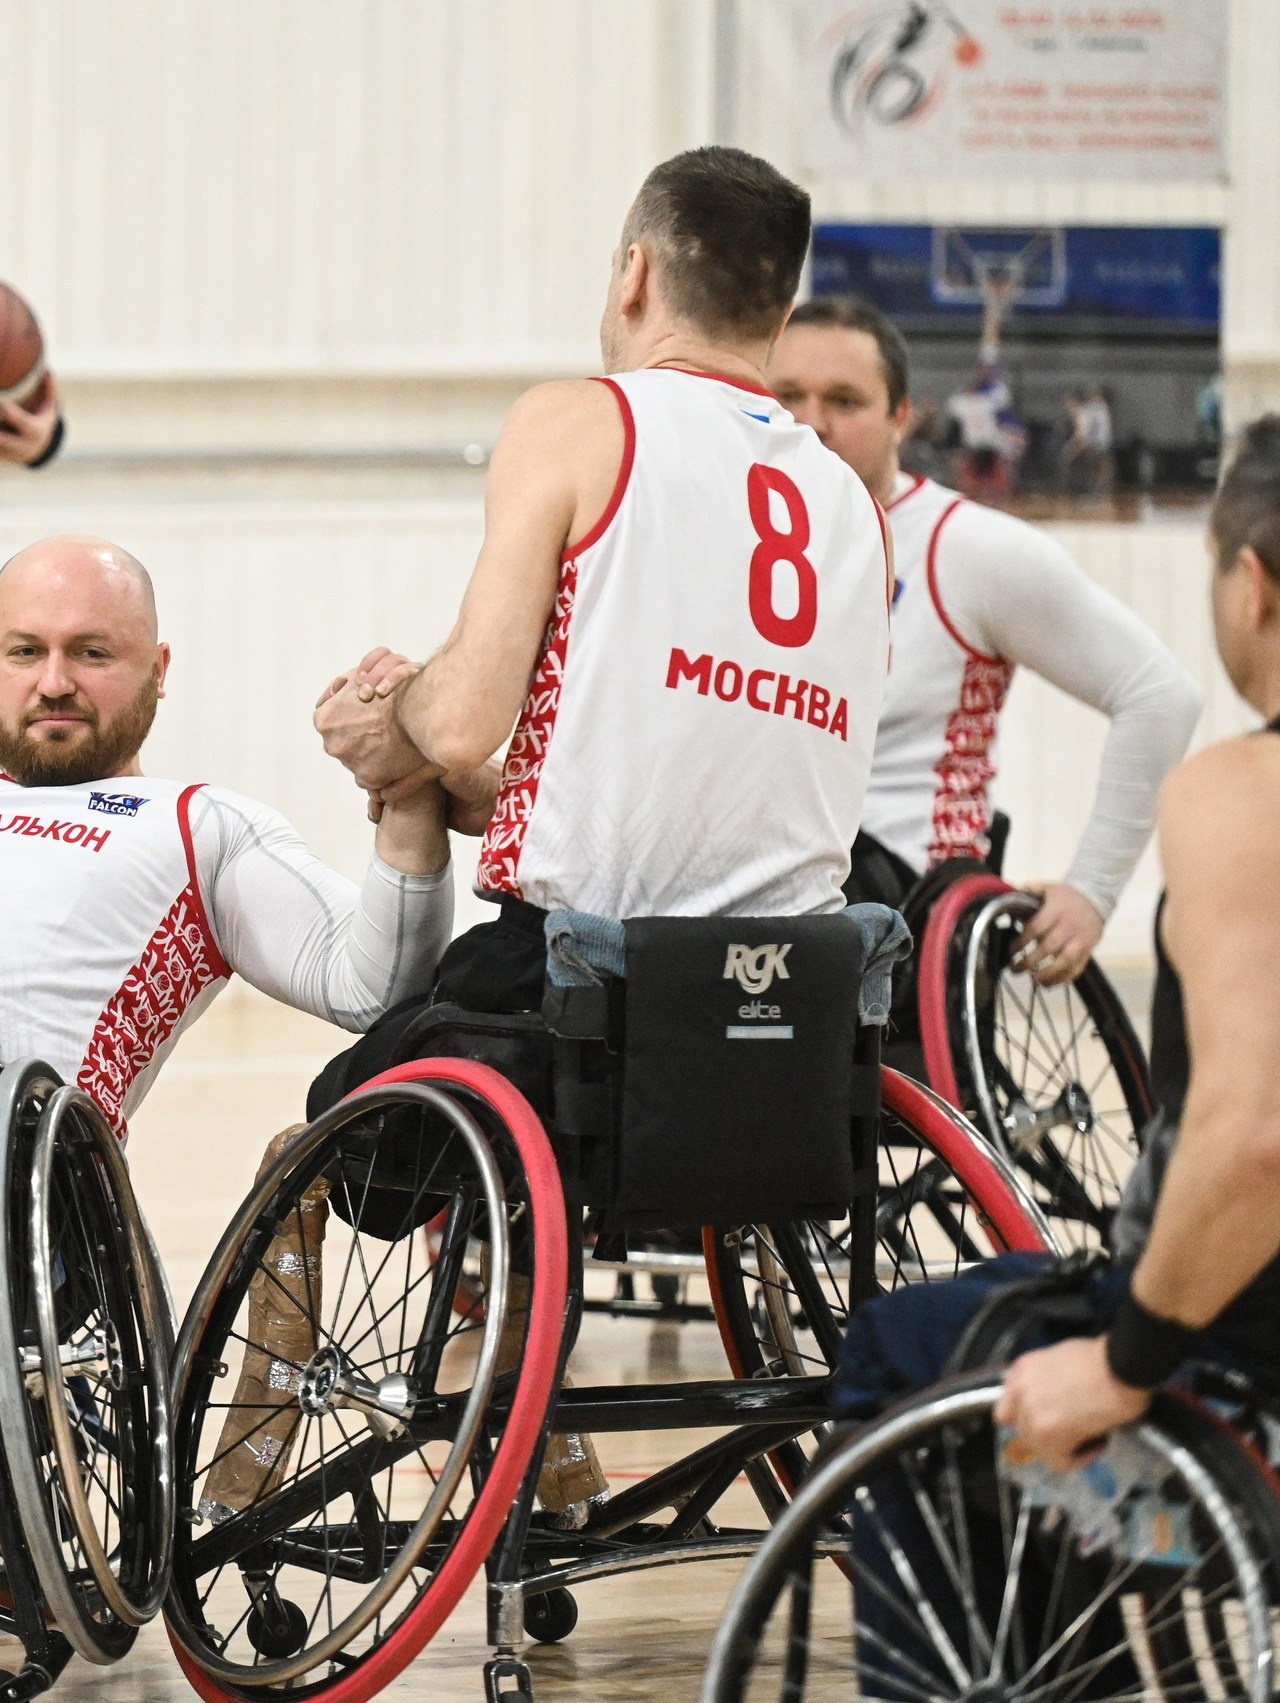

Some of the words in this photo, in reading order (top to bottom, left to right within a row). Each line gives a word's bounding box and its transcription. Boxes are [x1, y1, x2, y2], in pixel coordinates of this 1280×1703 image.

[747, 462, 818, 648] 8
[665, 647, 848, 742] МОСКВА
[90, 799, 136, 816] FALCON
[723, 943, 793, 994] RGK
[738, 1000, 781, 1018] elite
